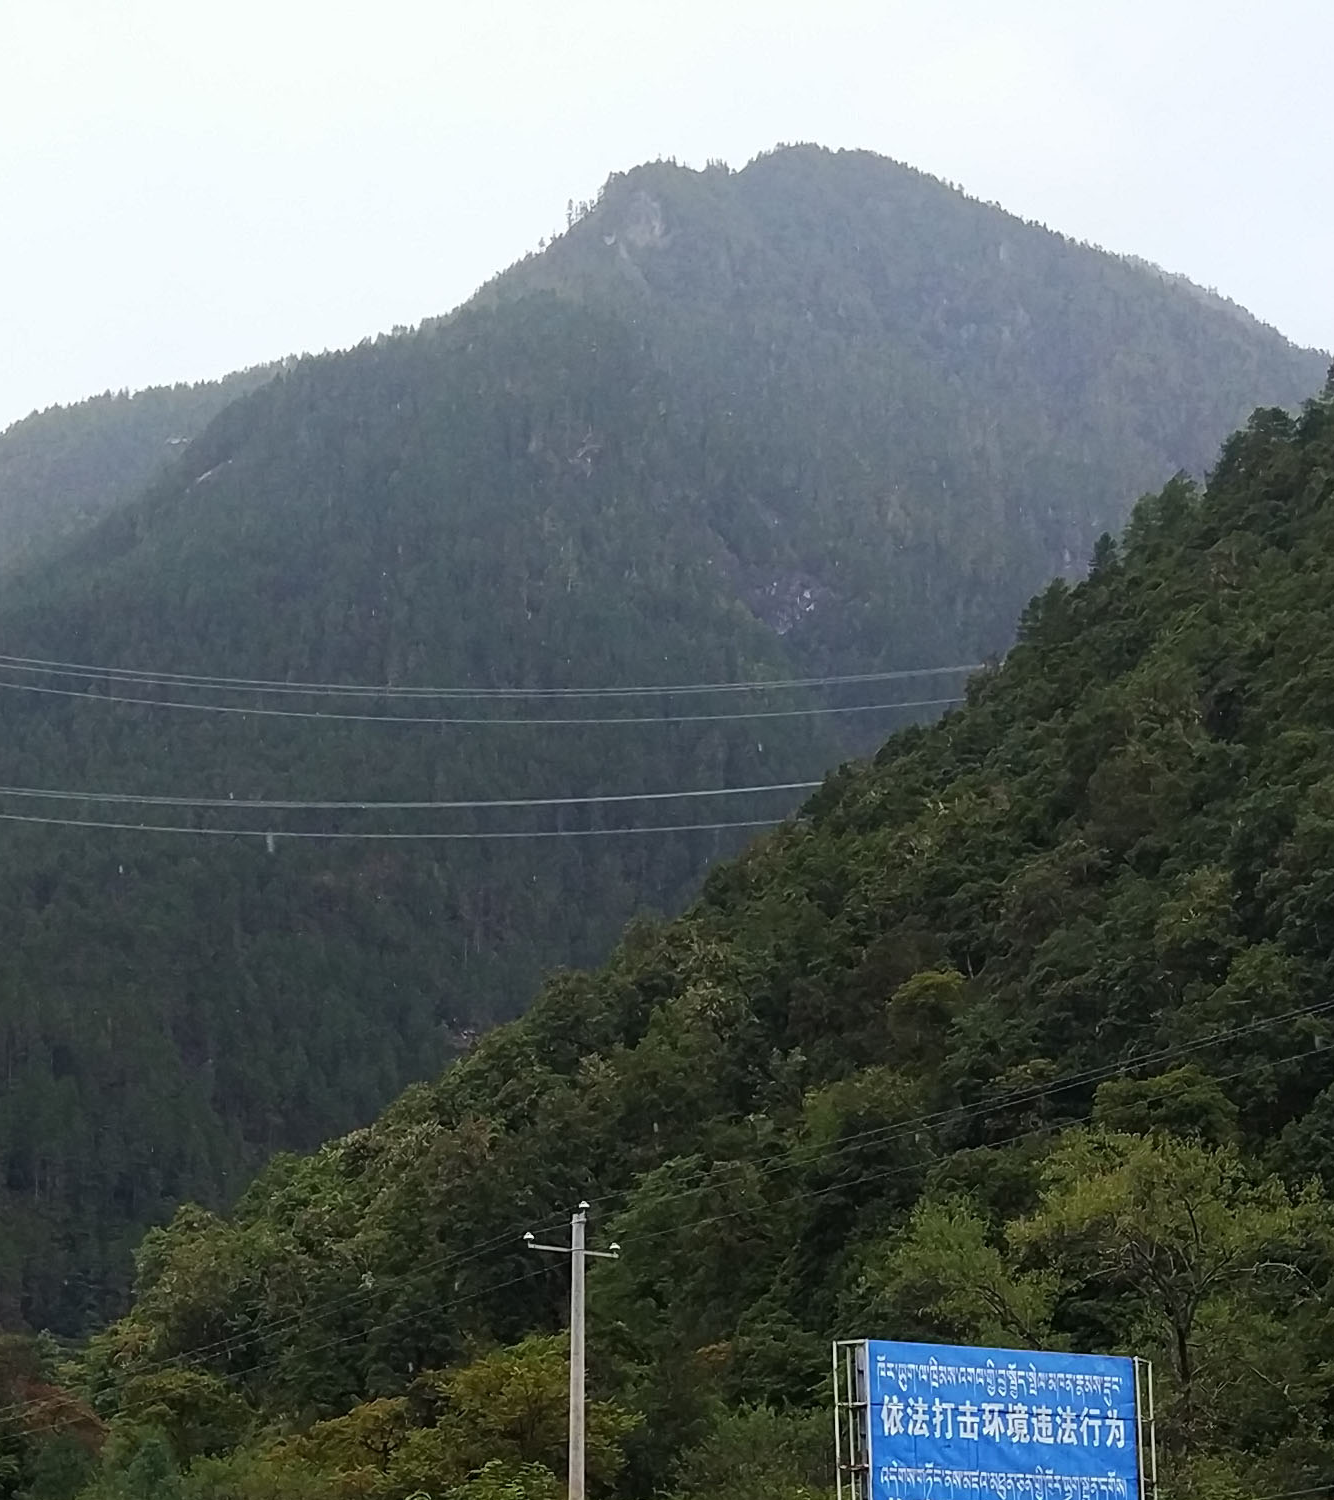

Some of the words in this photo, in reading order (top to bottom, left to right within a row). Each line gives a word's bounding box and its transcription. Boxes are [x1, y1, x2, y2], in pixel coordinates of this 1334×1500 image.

[880, 1394, 1126, 1449] 依法打击环境违法行为
